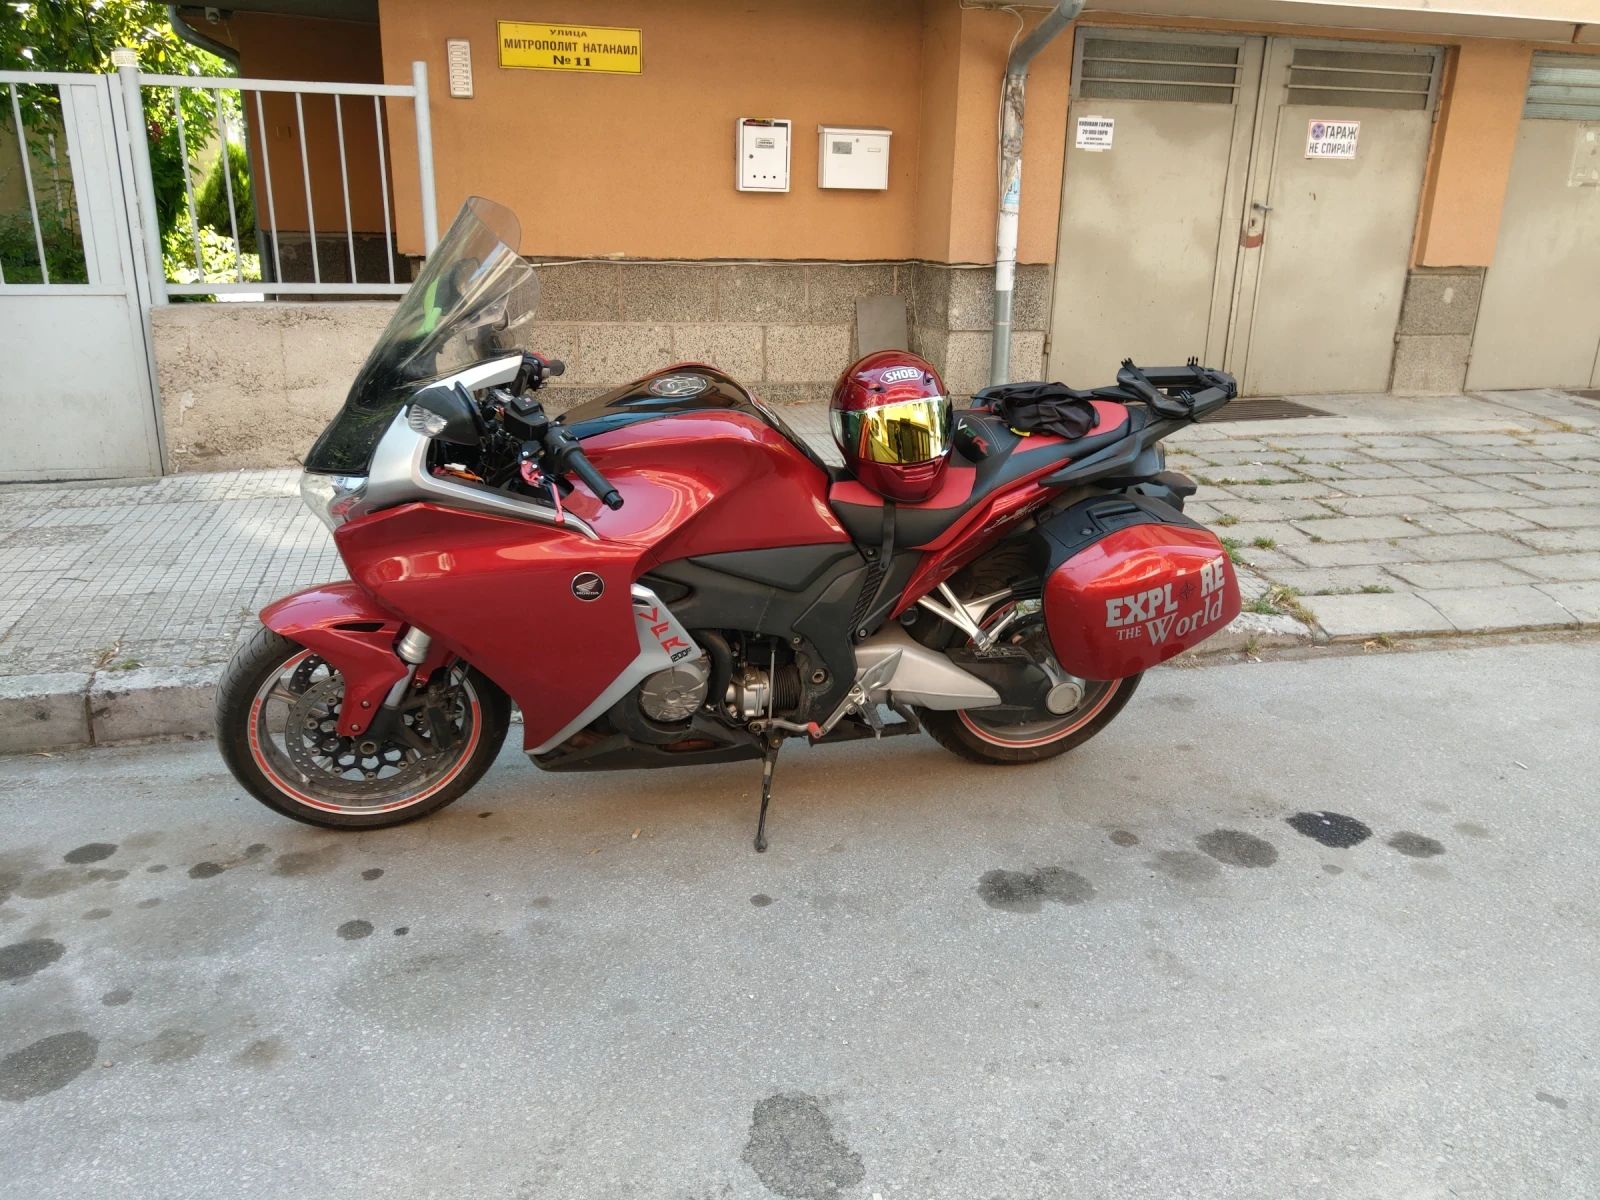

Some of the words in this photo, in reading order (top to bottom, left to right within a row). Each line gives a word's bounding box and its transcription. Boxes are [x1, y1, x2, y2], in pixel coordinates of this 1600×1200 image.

[550, 29, 587, 38] УЛИЦА
[504, 38, 578, 52] МИТРОПОЛИТ
[583, 43, 638, 55] НАТАНАИЛ
[574, 57, 591, 66] 11
[1325, 125, 1357, 140] ГАРАЖ
[1308, 142, 1319, 154] НЕ
[1321, 141, 1354, 155] СПИРАЙ!
[885, 369, 919, 382] SHOEI
[1116, 626, 1142, 640] THE
[1145, 588, 1224, 646] World
[637, 607, 689, 655] VFR
